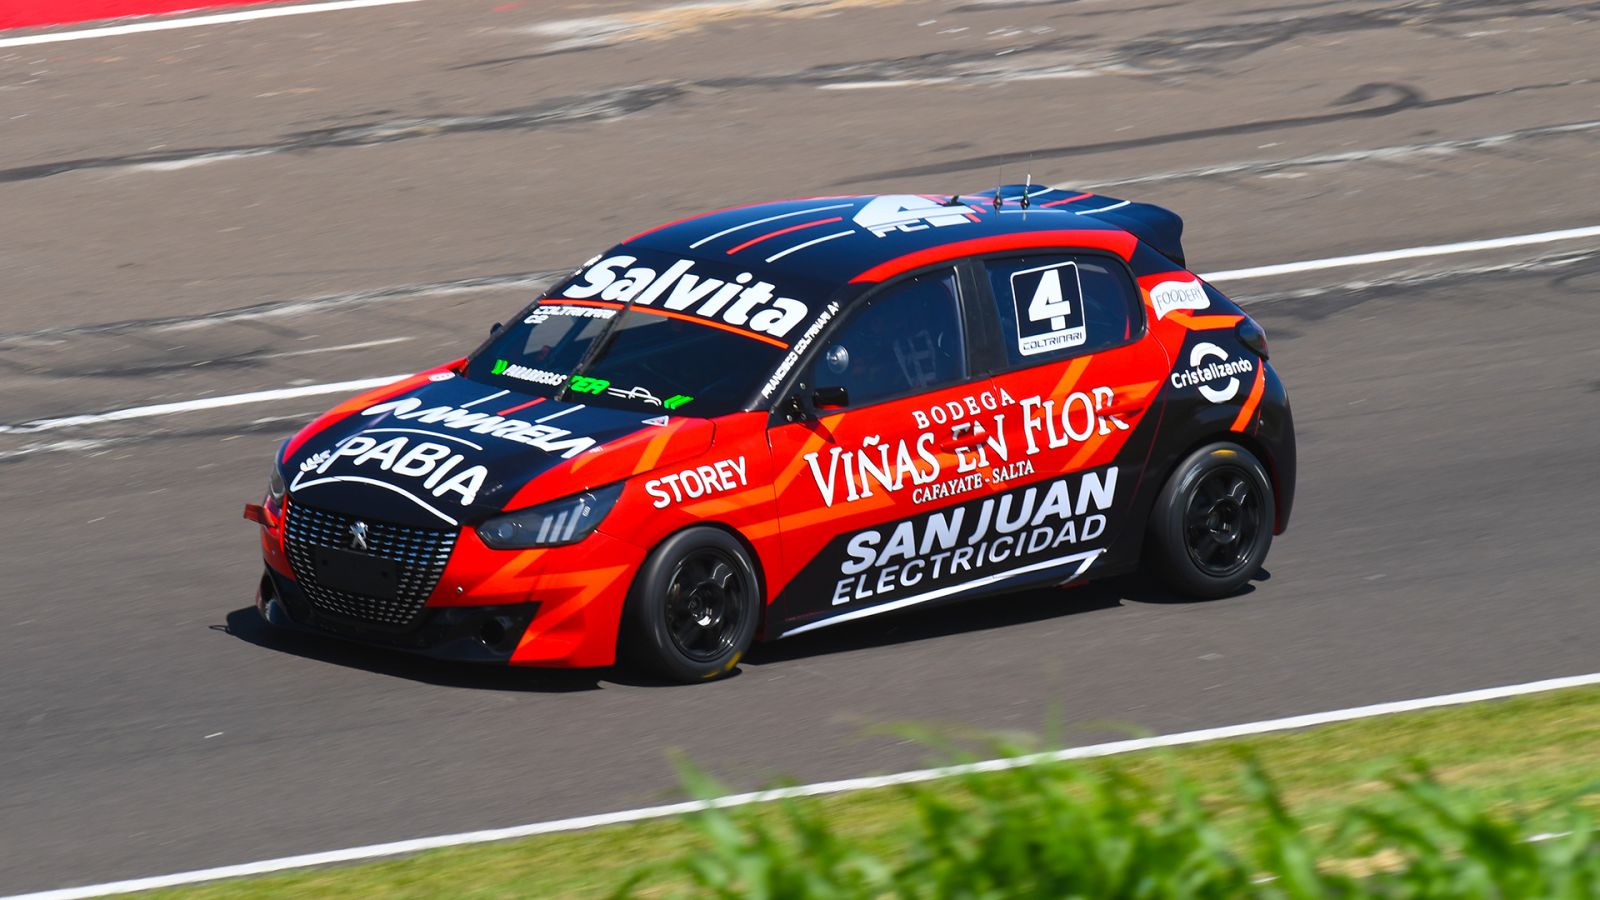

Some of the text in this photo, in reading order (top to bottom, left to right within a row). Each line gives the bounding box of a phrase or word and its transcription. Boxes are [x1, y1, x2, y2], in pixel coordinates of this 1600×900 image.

[562, 255, 808, 337] Salvita
[1028, 269, 1071, 331] 4
[761, 350, 799, 399] FRANCISCO
[793, 310, 832, 355] COLTRINARI
[1023, 332, 1083, 351] COLTRINARI
[1171, 356, 1253, 389] Cristalizando
[911, 387, 1016, 430] BODEGA
[316, 436, 488, 506] PABIA
[803, 431, 941, 508] VIÑAS
[1019, 386, 1131, 455] FLOR
[645, 456, 748, 508] STOREY
[912, 473, 983, 504] CAFAYATE
[992, 460, 1035, 485] SALTA
[841, 466, 1119, 576] SAN JUAN
[831, 514, 1107, 606] ELECTRICIDAD
